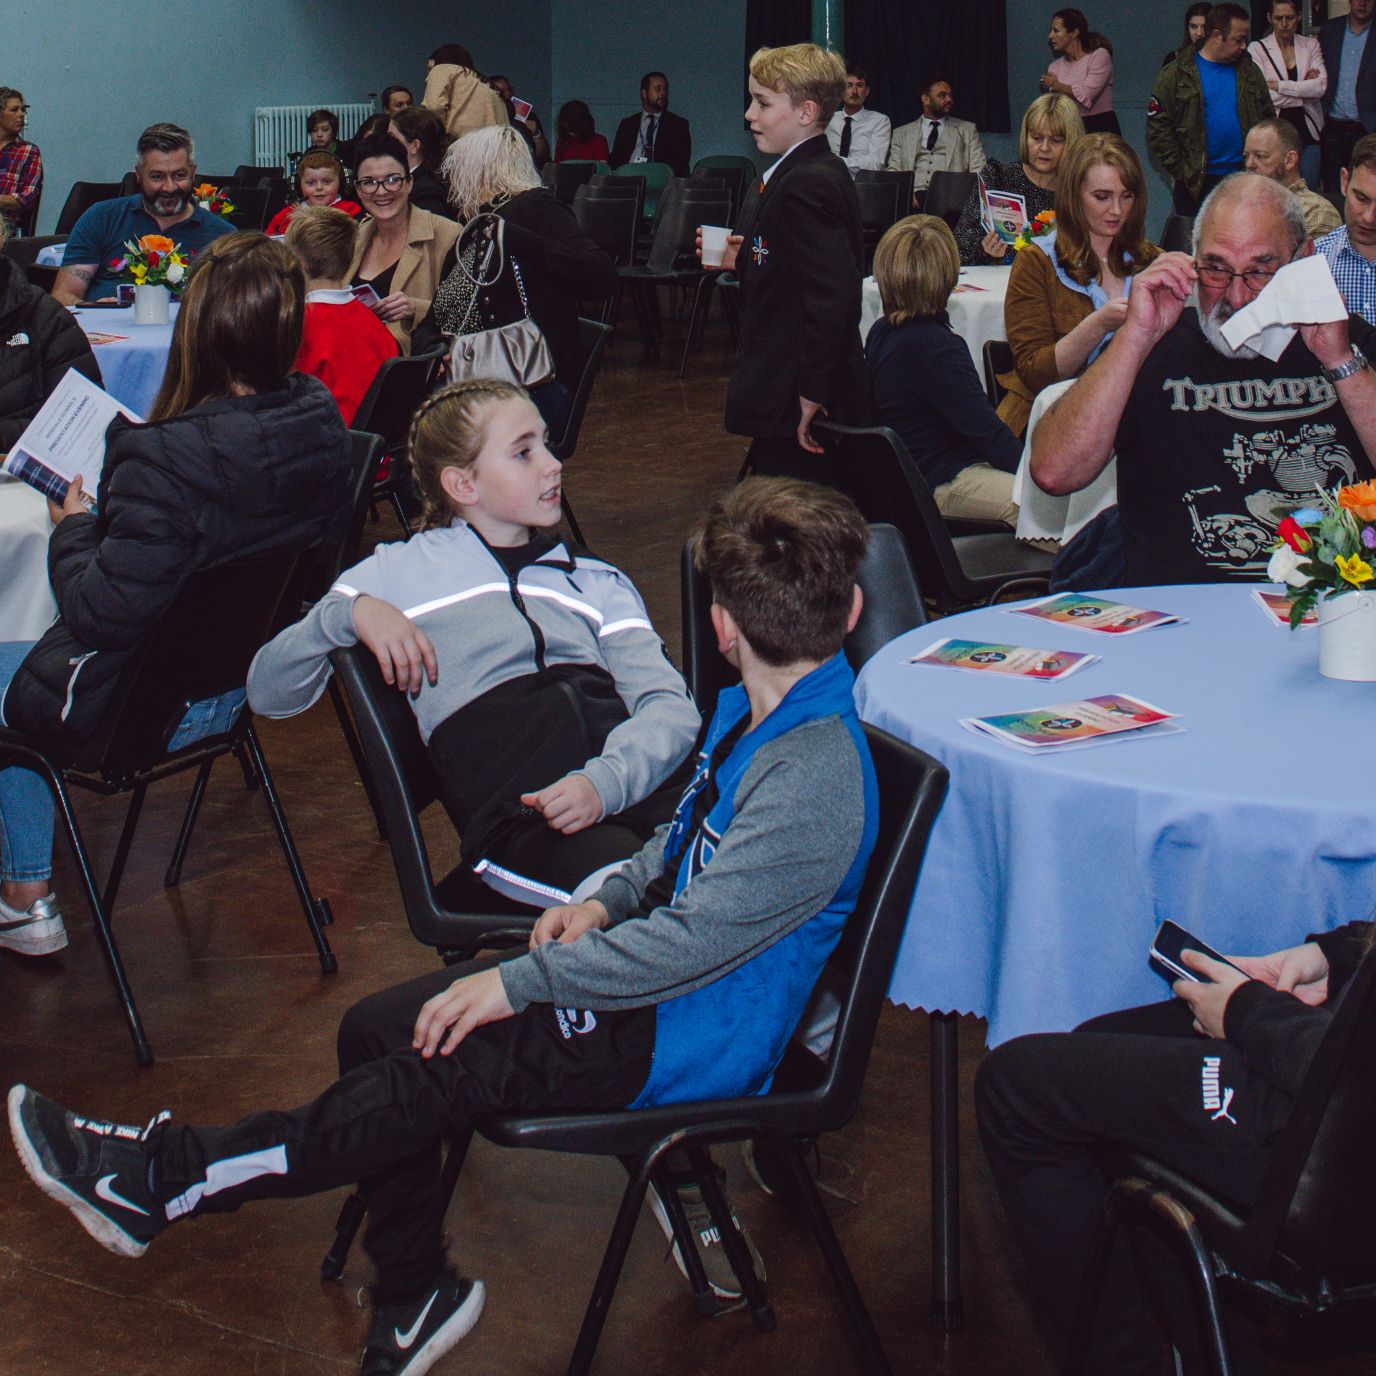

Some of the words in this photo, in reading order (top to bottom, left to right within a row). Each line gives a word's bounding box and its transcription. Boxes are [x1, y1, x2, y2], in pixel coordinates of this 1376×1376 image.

[1162, 376, 1337, 412] TRIUMPH
[554, 1007, 572, 1039] ondico
[1202, 1055, 1221, 1110] PUMA
